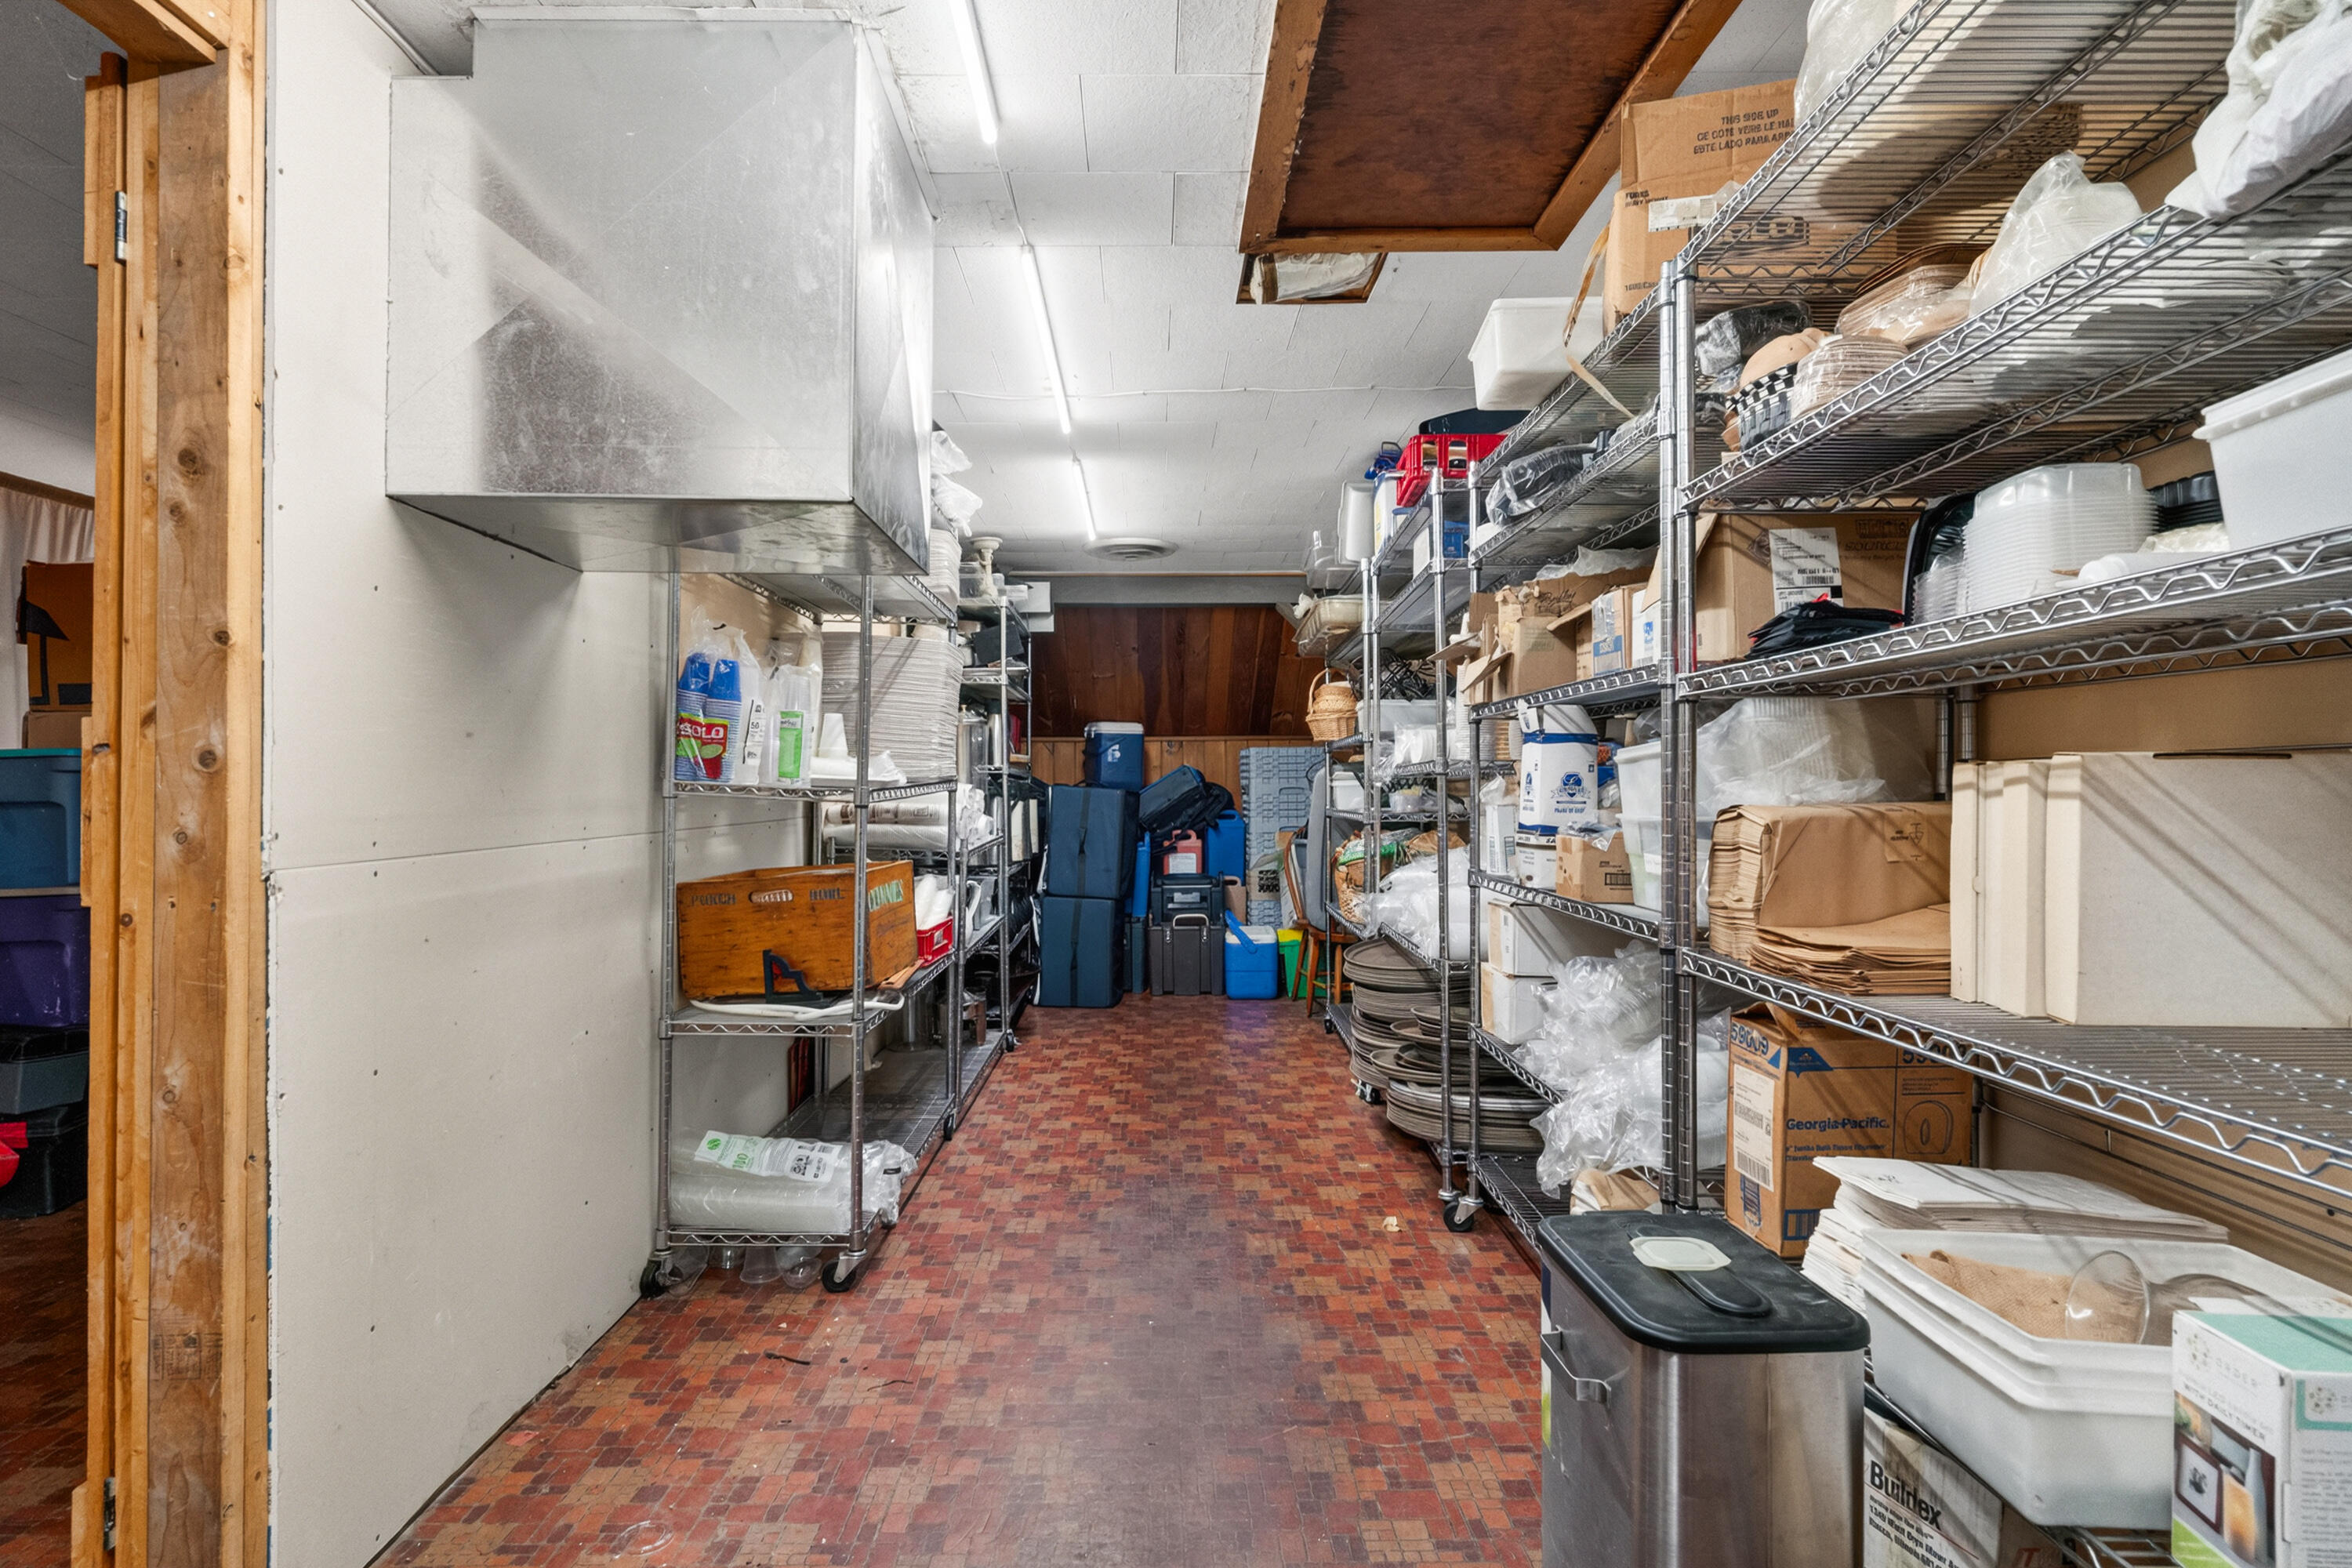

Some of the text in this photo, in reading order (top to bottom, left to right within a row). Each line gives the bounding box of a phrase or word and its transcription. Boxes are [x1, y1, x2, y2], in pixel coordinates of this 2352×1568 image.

[1721, 109, 1779, 125] THIS SIDE UP
[1764, 122, 1776, 130] LE
[1719, 138, 1743, 151] LADO
[681, 723, 724, 739] SOLO
[750, 721, 760, 730] 50
[1870, 1459, 1942, 1530] Buildex
